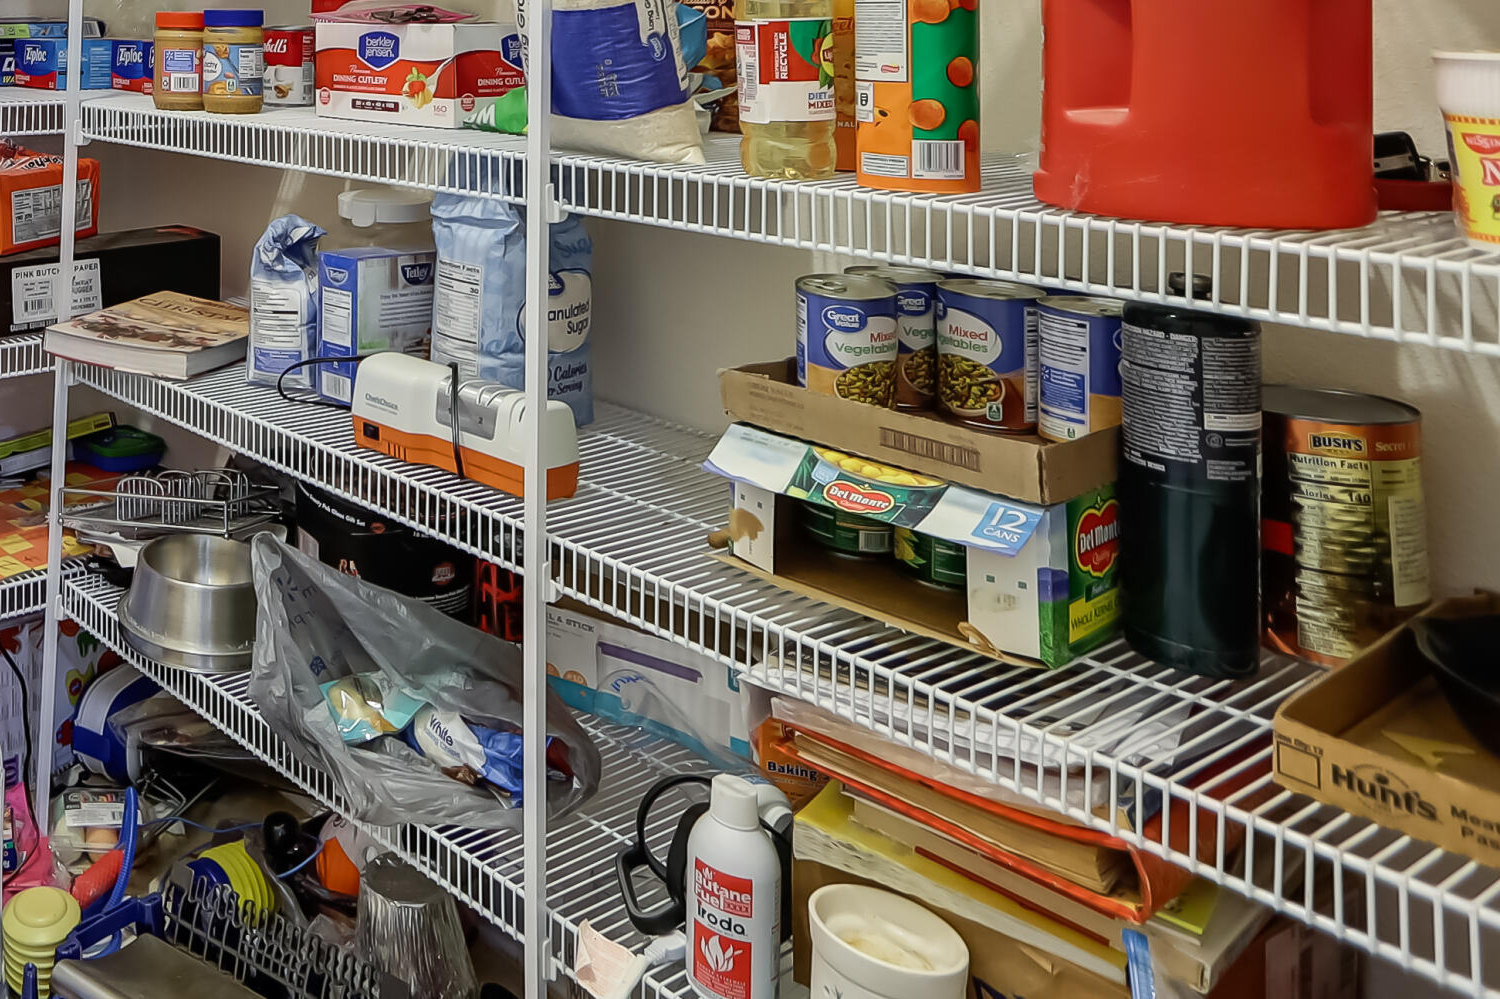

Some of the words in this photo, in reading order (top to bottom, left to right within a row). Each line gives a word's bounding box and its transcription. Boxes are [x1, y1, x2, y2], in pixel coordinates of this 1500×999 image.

[366, 36, 396, 49] berkley
[25, 46, 47, 65] Ziploc
[118, 46, 143, 65] Ziploc
[365, 47, 394, 59] jensen
[779, 32, 789, 80] RECYCLE
[333, 74, 357, 83] DINING
[357, 75, 389, 85] CUTLERY
[477, 77, 504, 86] DINING
[808, 91, 828, 101] DIET
[433, 105, 448, 113] 160
[15, 268, 34, 279] PINK
[73, 262, 99, 272] PAPER
[403, 265, 429, 279] Tetley
[469, 287, 479, 295] 30
[548, 299, 589, 321] anulated
[827, 310, 861, 323] Great
[948, 324, 989, 342] Mixed
[554, 361, 588, 381] Calories
[556, 380, 583, 396] Serving
[477, 416, 483, 425] 2
[1311, 435, 1363, 452] BUSH'S
[1290, 453, 1337, 468] Nutrition
[1340, 460, 1369, 471] Facts
[827, 484, 848, 500] Del
[849, 490, 890, 510] Monte
[990, 506, 1028, 532] 12
[982, 526, 1021, 544] CANS
[1080, 528, 1095, 554] Del
[565, 617, 595, 633] STICK
[1071, 612, 1093, 631] WHOLE
[429, 713, 454, 747] White
[767, 760, 817, 782] Baking
[1331, 762, 1438, 822] Hunt's
[695, 869, 752, 904] Butane
[694, 882, 724, 911] Fuel
